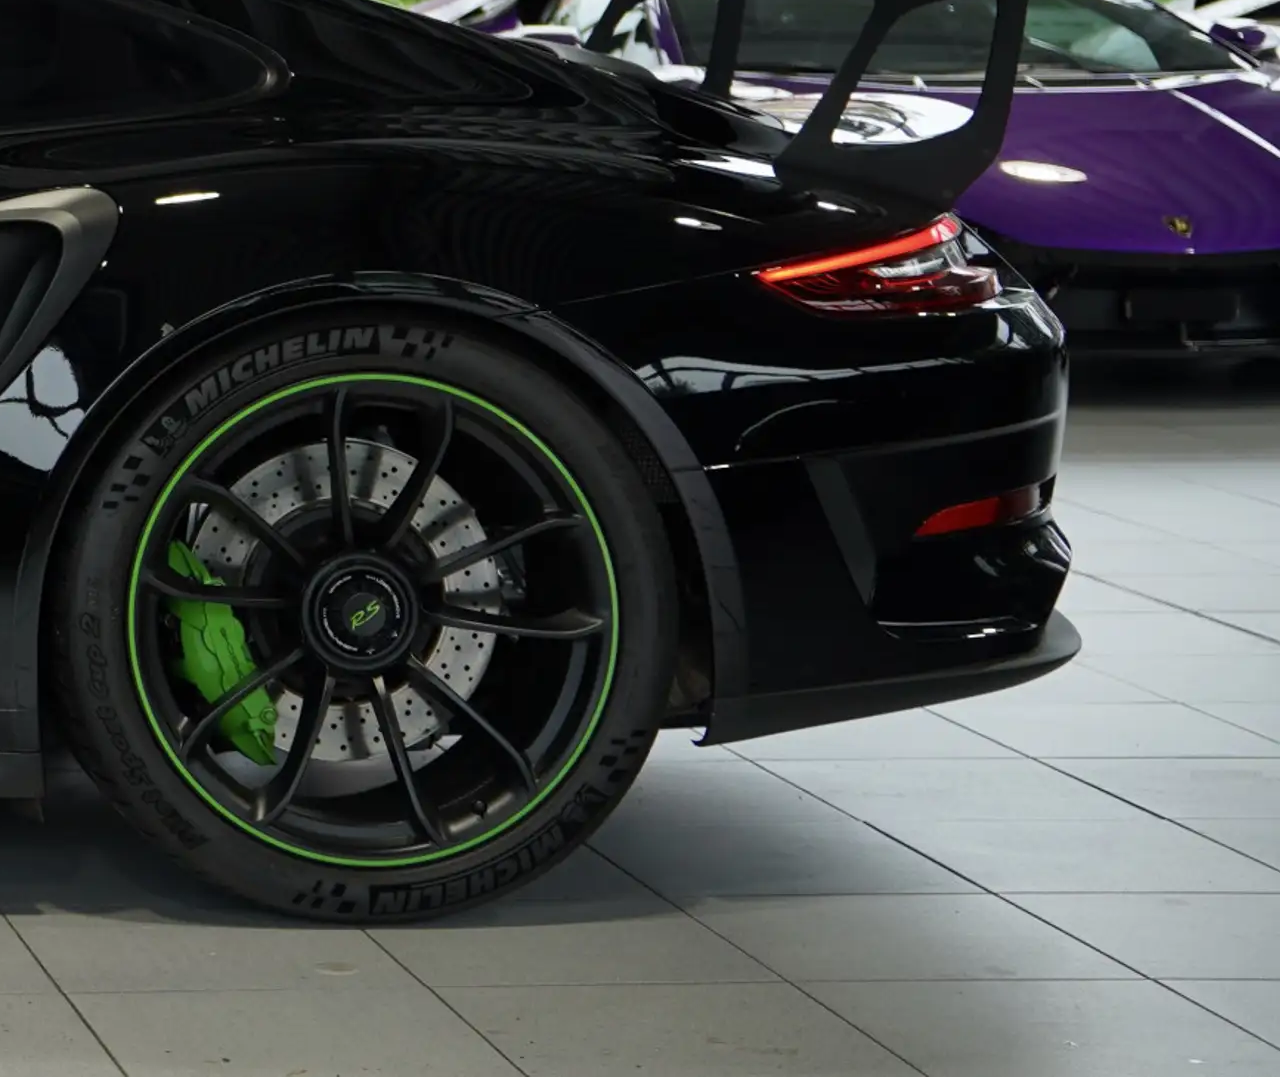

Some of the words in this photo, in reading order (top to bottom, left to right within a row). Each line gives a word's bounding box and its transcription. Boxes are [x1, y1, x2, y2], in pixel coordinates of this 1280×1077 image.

[183, 326, 378, 415] MICHELIN
[79, 612, 101, 639] 2
[350, 599, 381, 632] RS
[86, 644, 110, 700] Cup
[95, 705, 156, 787] Sport
[373, 824, 565, 915] MICHELIN
